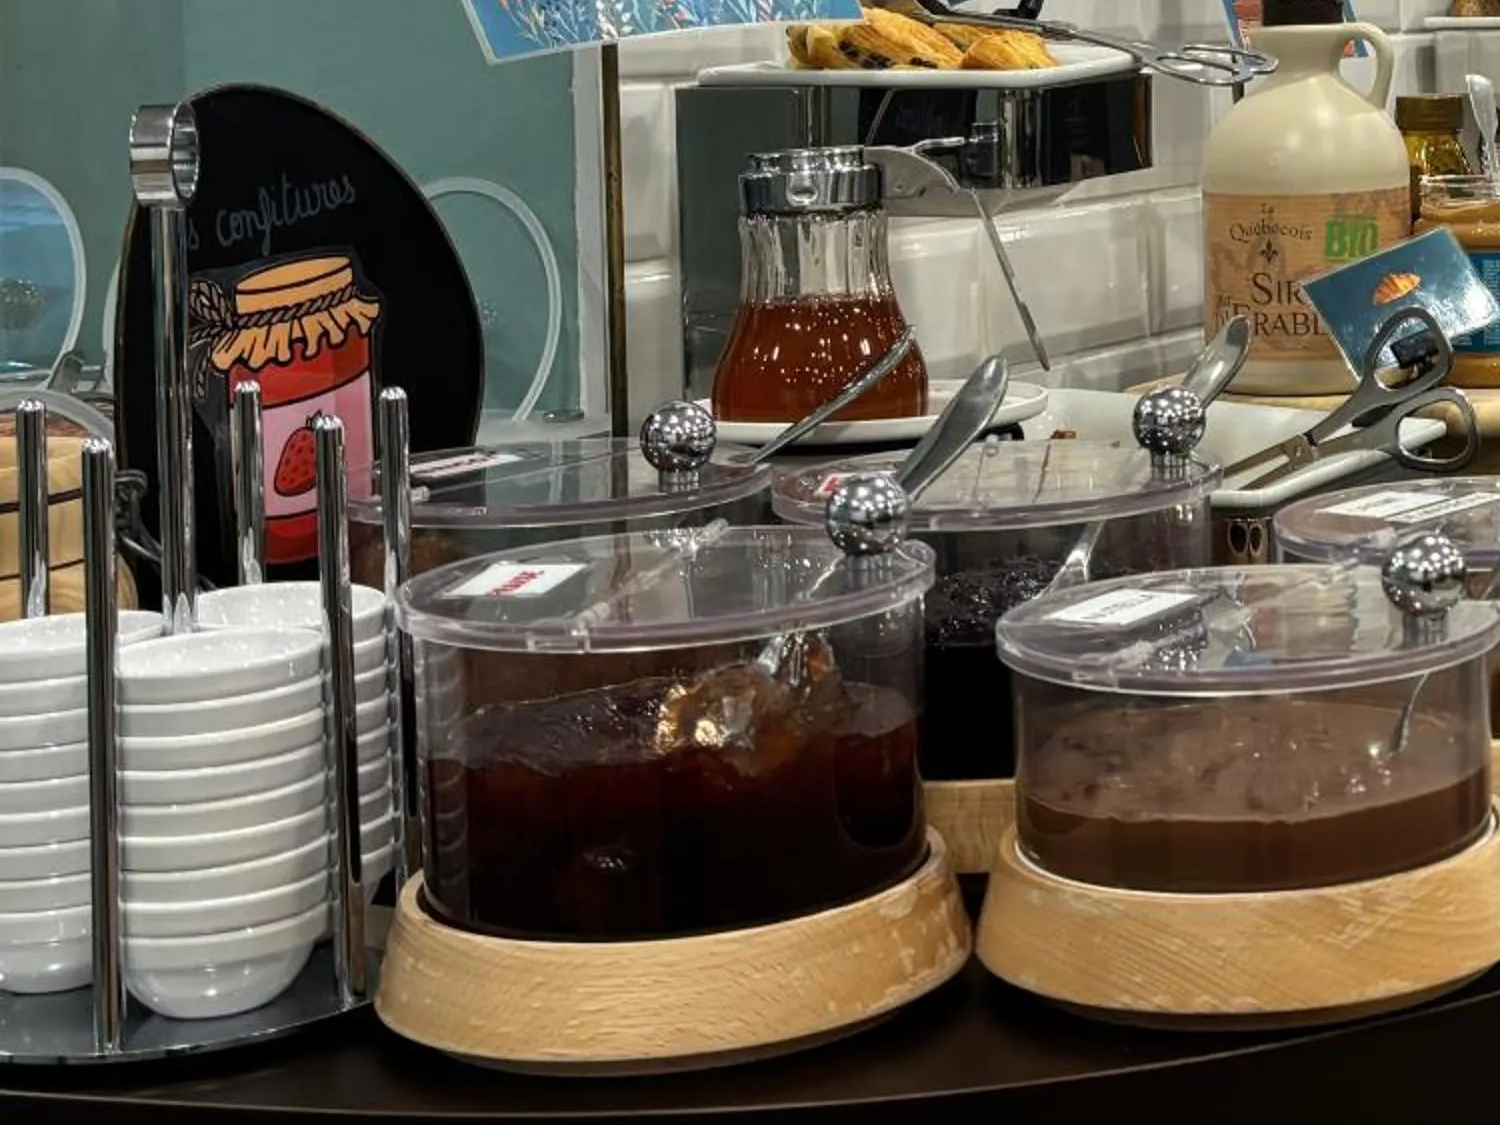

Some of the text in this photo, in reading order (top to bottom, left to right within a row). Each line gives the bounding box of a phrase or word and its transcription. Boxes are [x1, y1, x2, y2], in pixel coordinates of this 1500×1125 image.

[216, 171, 356, 257] confitures
[1325, 218, 1379, 259] BIO
[1252, 272, 1308, 306] SIR
